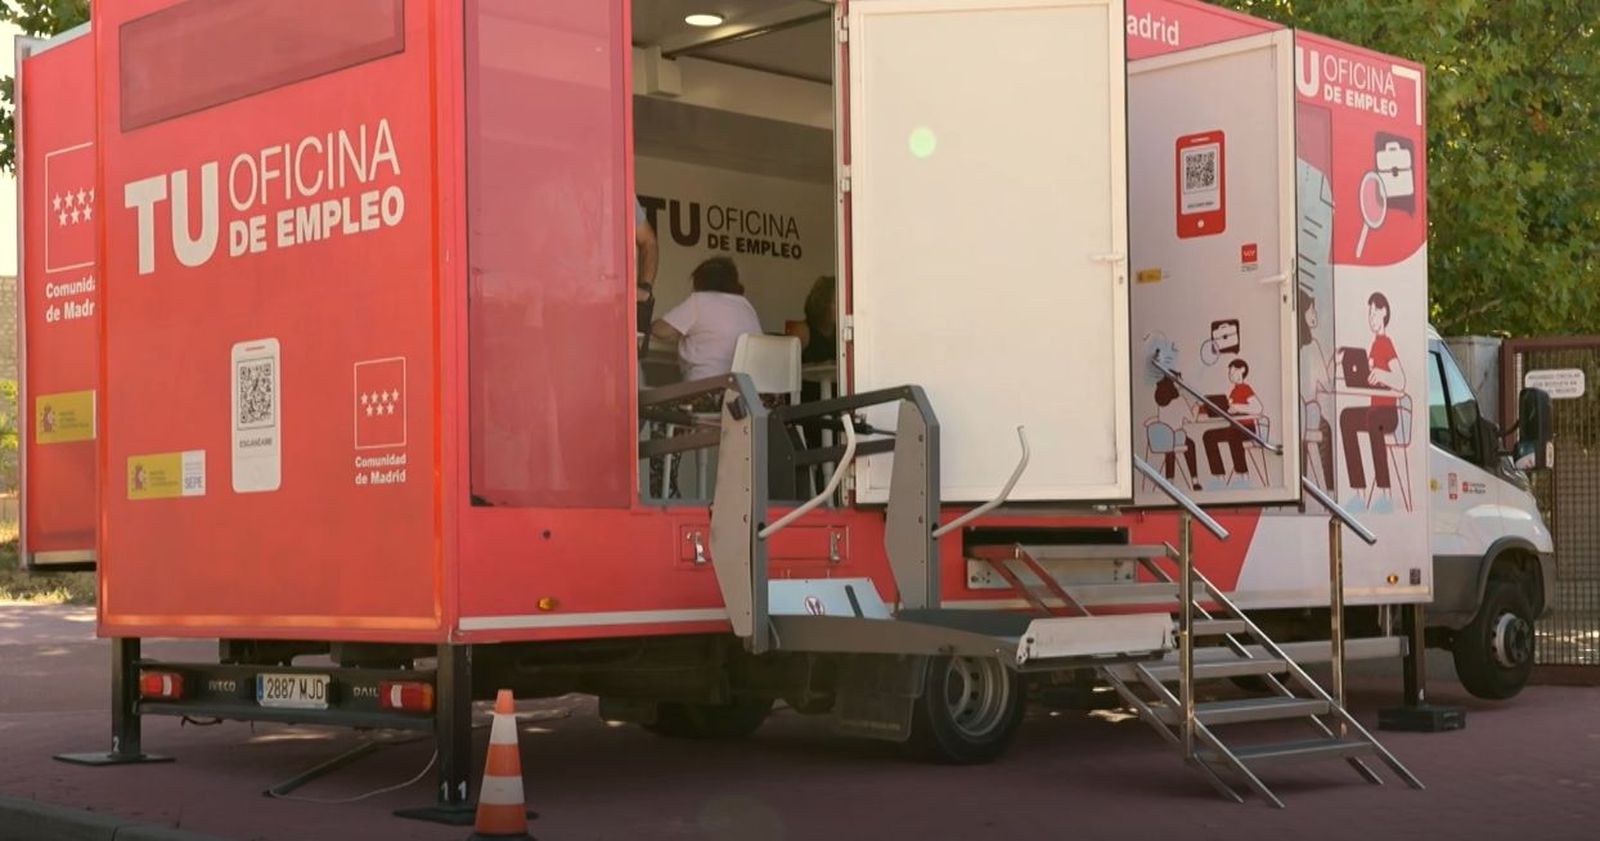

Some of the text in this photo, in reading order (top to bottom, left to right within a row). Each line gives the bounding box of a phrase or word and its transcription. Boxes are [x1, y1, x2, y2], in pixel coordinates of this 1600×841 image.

[1127, 12, 1179, 46] adrid
[1295, 46, 1320, 97] U
[1323, 55, 1396, 97] OFICINA
[1324, 84, 1398, 118] DE EMPLEO
[228, 118, 401, 212] OFICINA
[124, 161, 219, 275] TU
[229, 186, 405, 257] DE EMPLEO
[636, 195, 701, 247] TU
[706, 205, 800, 240] OFICINA
[707, 233, 803, 260] DE EMPLEO
[45, 274, 96, 299] Comunid
[46, 298, 96, 322] de Madr
[355, 452, 407, 468] Comunidad
[355, 469, 407, 485] de Madrid
[266, 677, 324, 700] 2887 MJD
[353, 686, 379, 697] DAIL
[113, 736, 120, 752] 2
